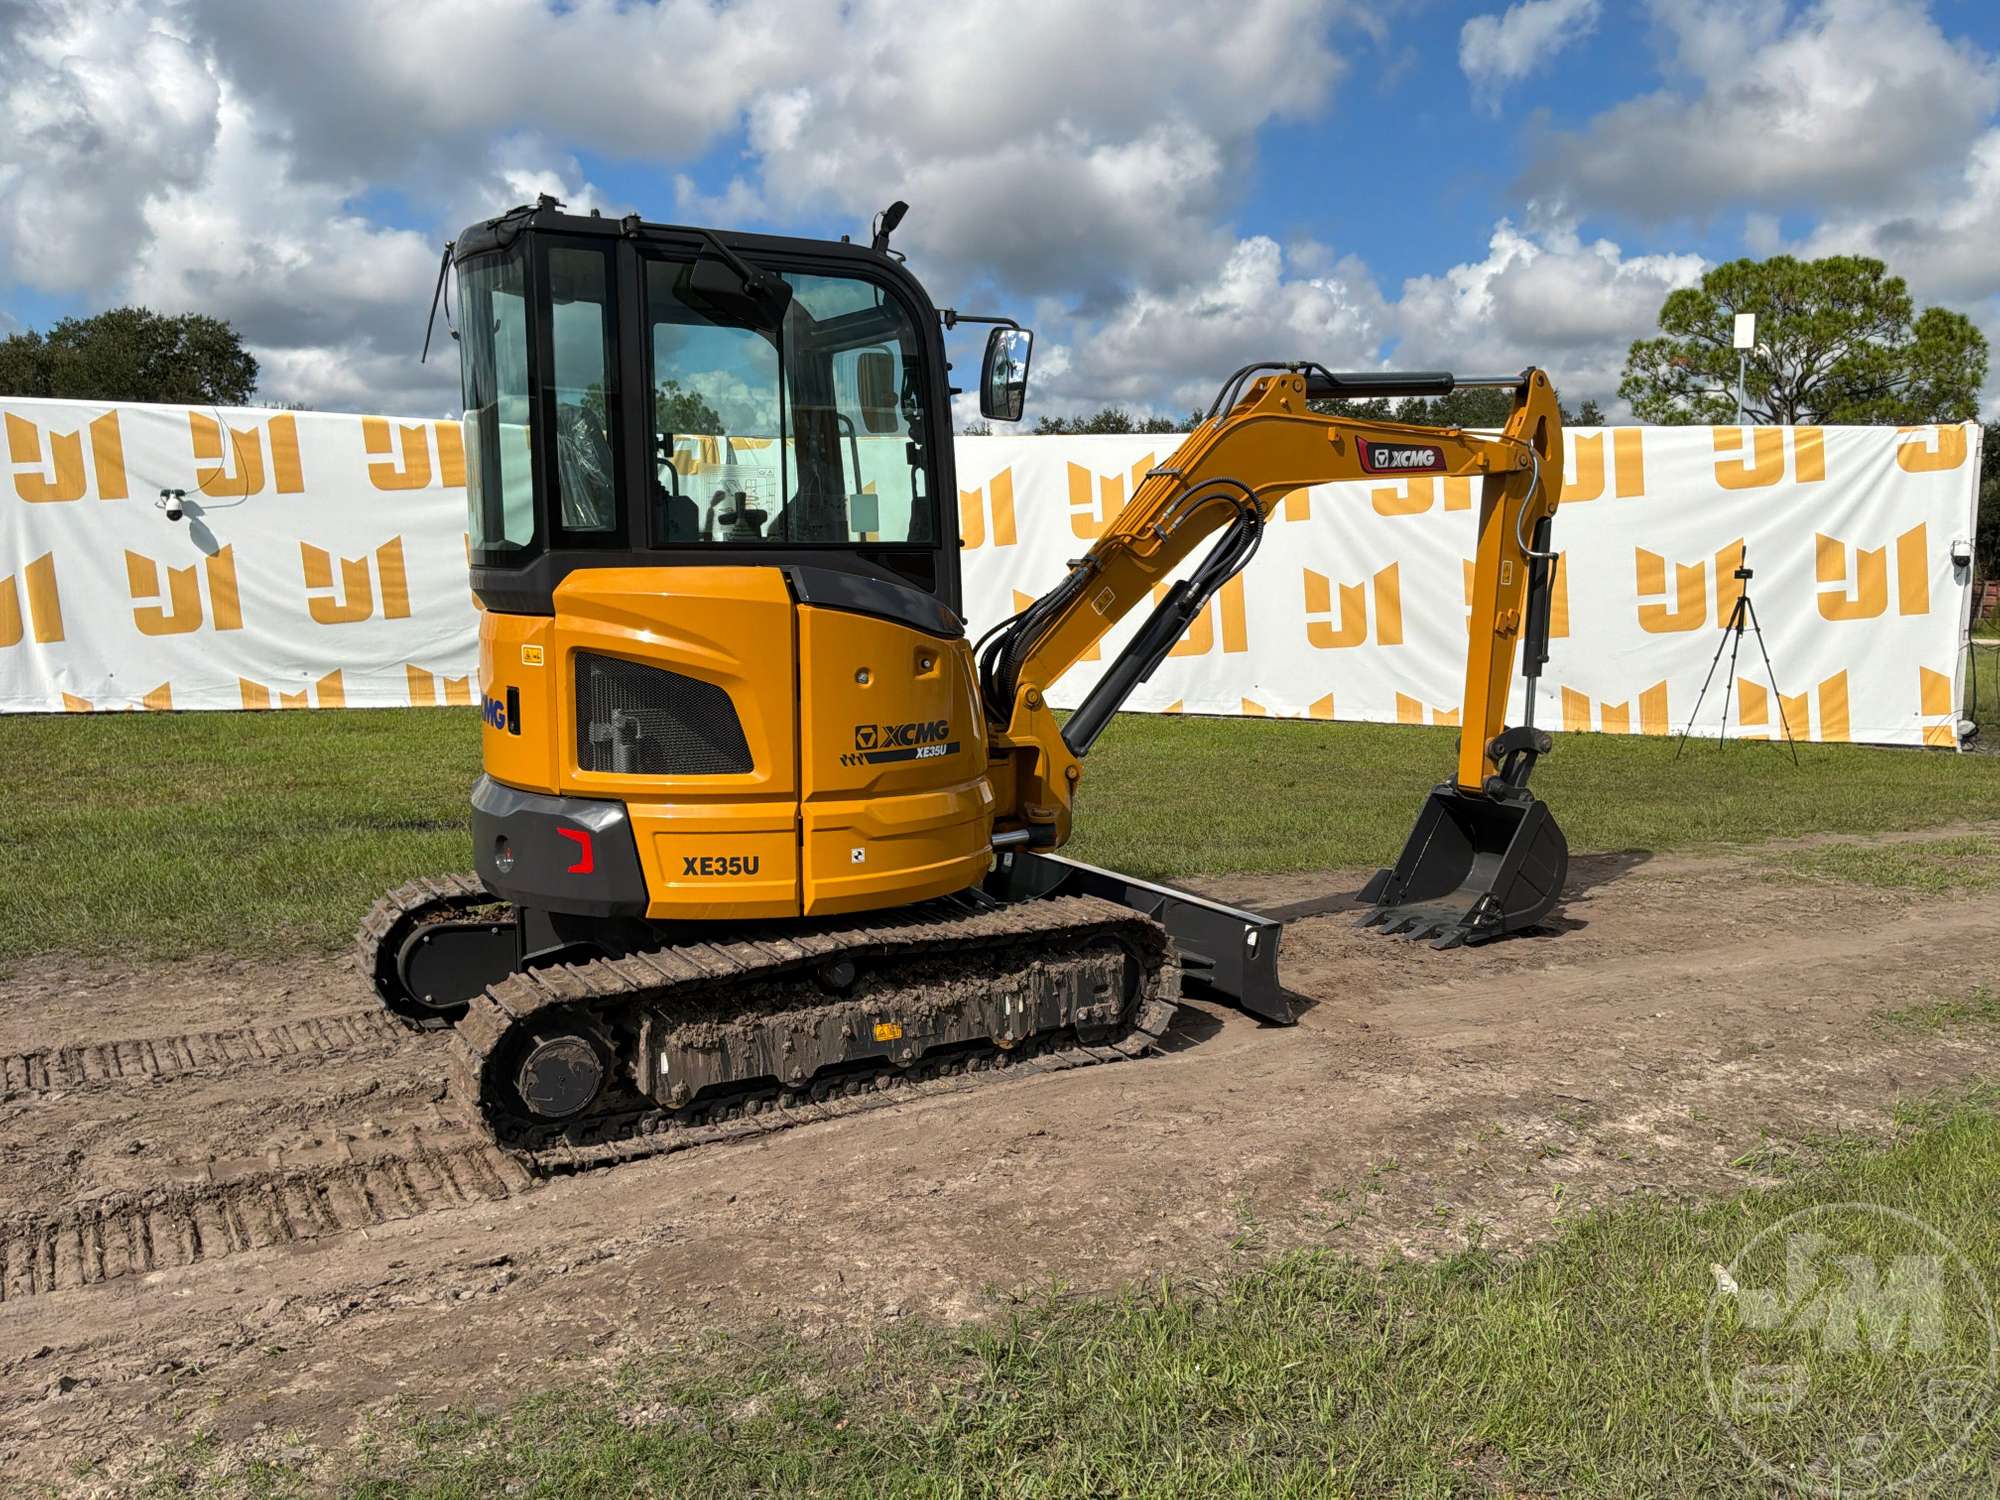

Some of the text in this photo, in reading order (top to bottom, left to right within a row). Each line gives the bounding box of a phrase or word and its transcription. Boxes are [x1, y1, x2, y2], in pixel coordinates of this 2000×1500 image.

[1391, 450, 1435, 467] XCMG
[881, 720, 949, 748] XCMG
[915, 744, 947, 759] XE35U
[683, 856, 759, 875] XE35U
